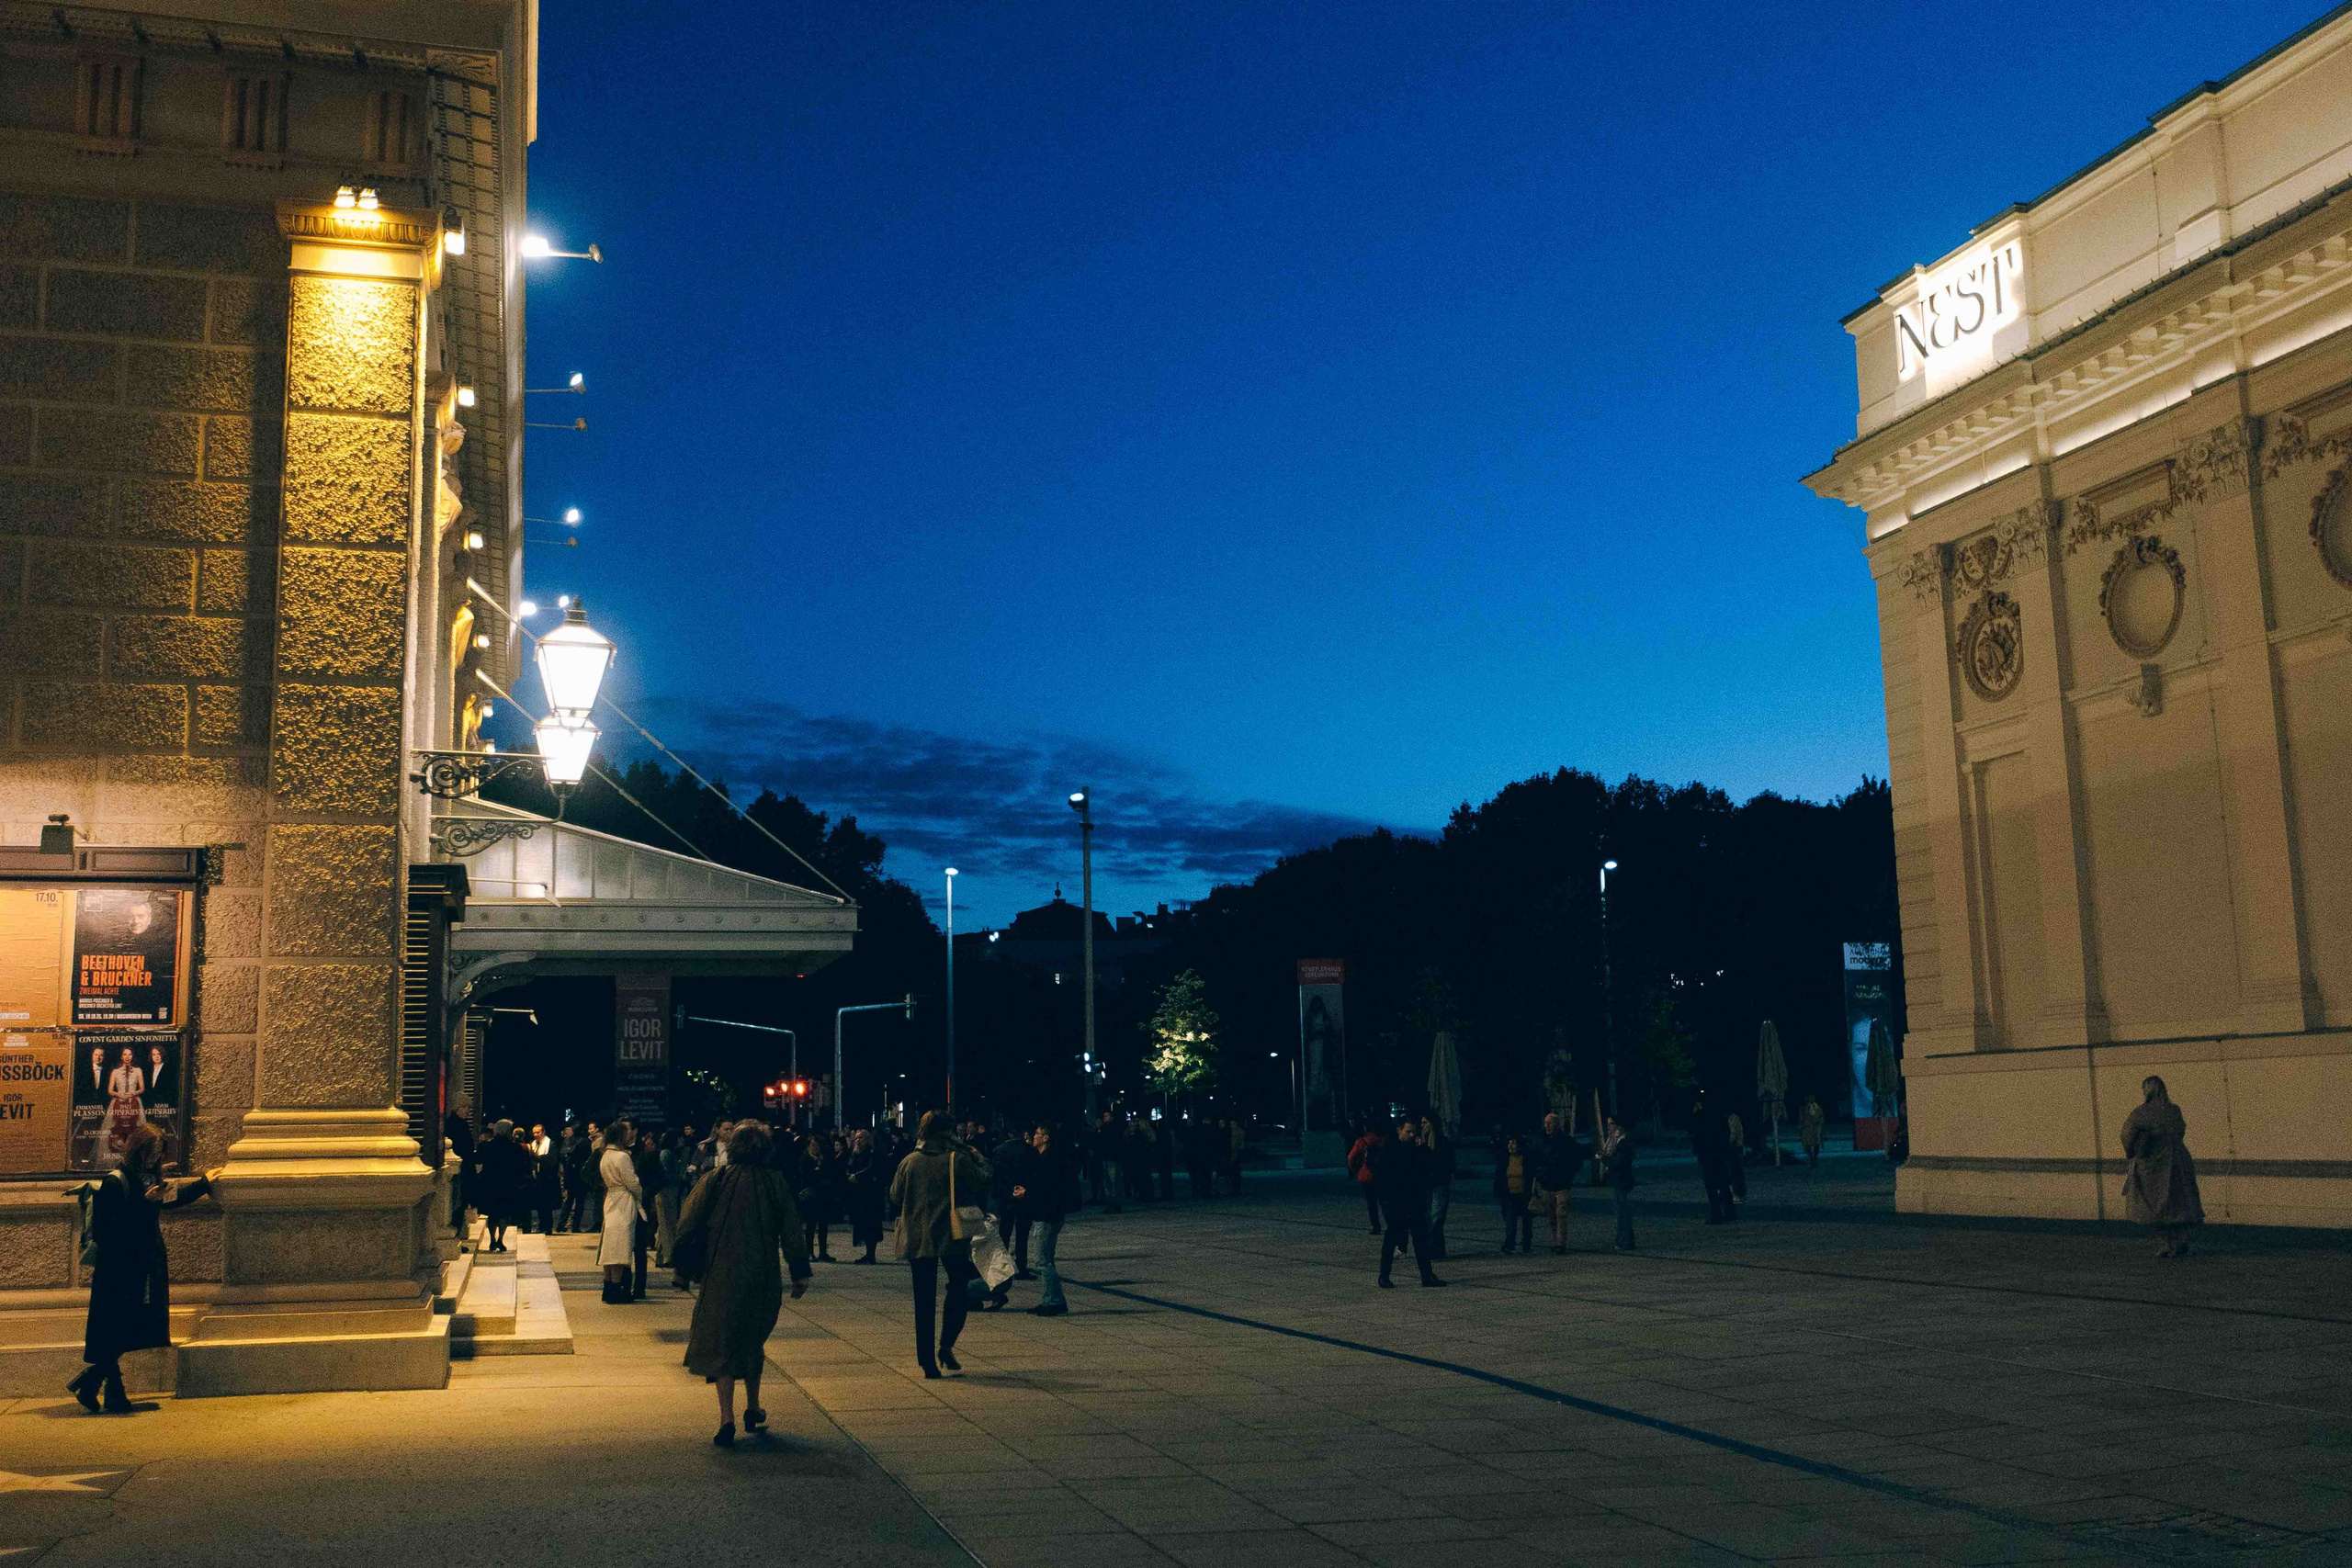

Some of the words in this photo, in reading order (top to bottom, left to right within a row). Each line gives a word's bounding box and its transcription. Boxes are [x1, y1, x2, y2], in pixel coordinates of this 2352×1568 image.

[1894, 246, 2015, 373] NEST
[81, 954, 145, 971] BEETHOVEN
[81, 971, 89, 986] &
[92, 971, 153, 987] BRUCKNER
[623, 1018, 662, 1038] IGOR
[79, 1035, 106, 1043] COVENT
[135, 1034, 177, 1043] SINFONIETTA
[619, 1040, 665, 1060] LEVIT
[0, 1061, 65, 1081] SSBÖCK
[4, 1093, 23, 1102] IGOR
